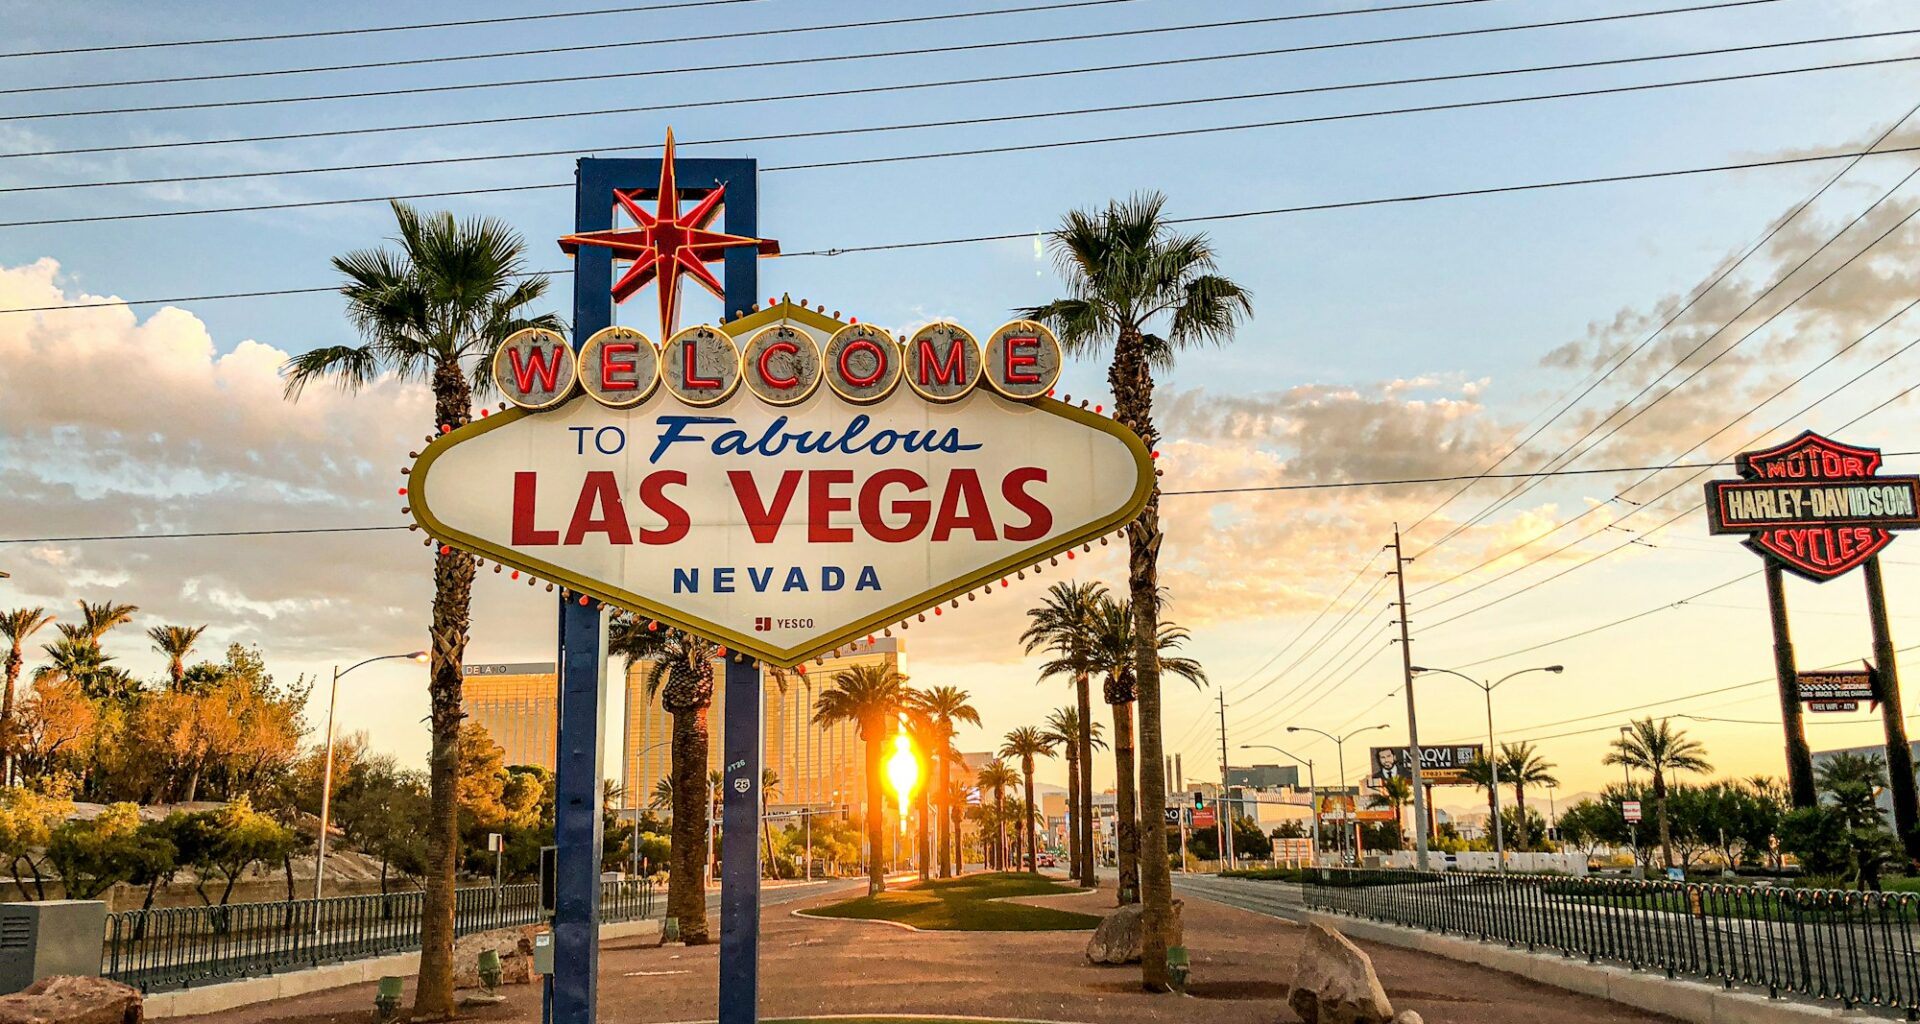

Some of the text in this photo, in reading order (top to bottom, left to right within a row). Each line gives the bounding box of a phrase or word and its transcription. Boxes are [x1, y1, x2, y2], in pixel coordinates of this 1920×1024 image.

[507, 335, 1041, 394] WELCOME
[568, 413, 984, 465] TO Fabulous
[1766, 444, 1865, 479] MOTOR
[510, 466, 1053, 546] LAS VEGAS
[1727, 485, 1913, 520] HARLEY-DAVIDSON
[1774, 527, 1873, 566] CYCLES
[673, 564, 883, 594] NEVADA
[735, 781, 749, 789] 25
